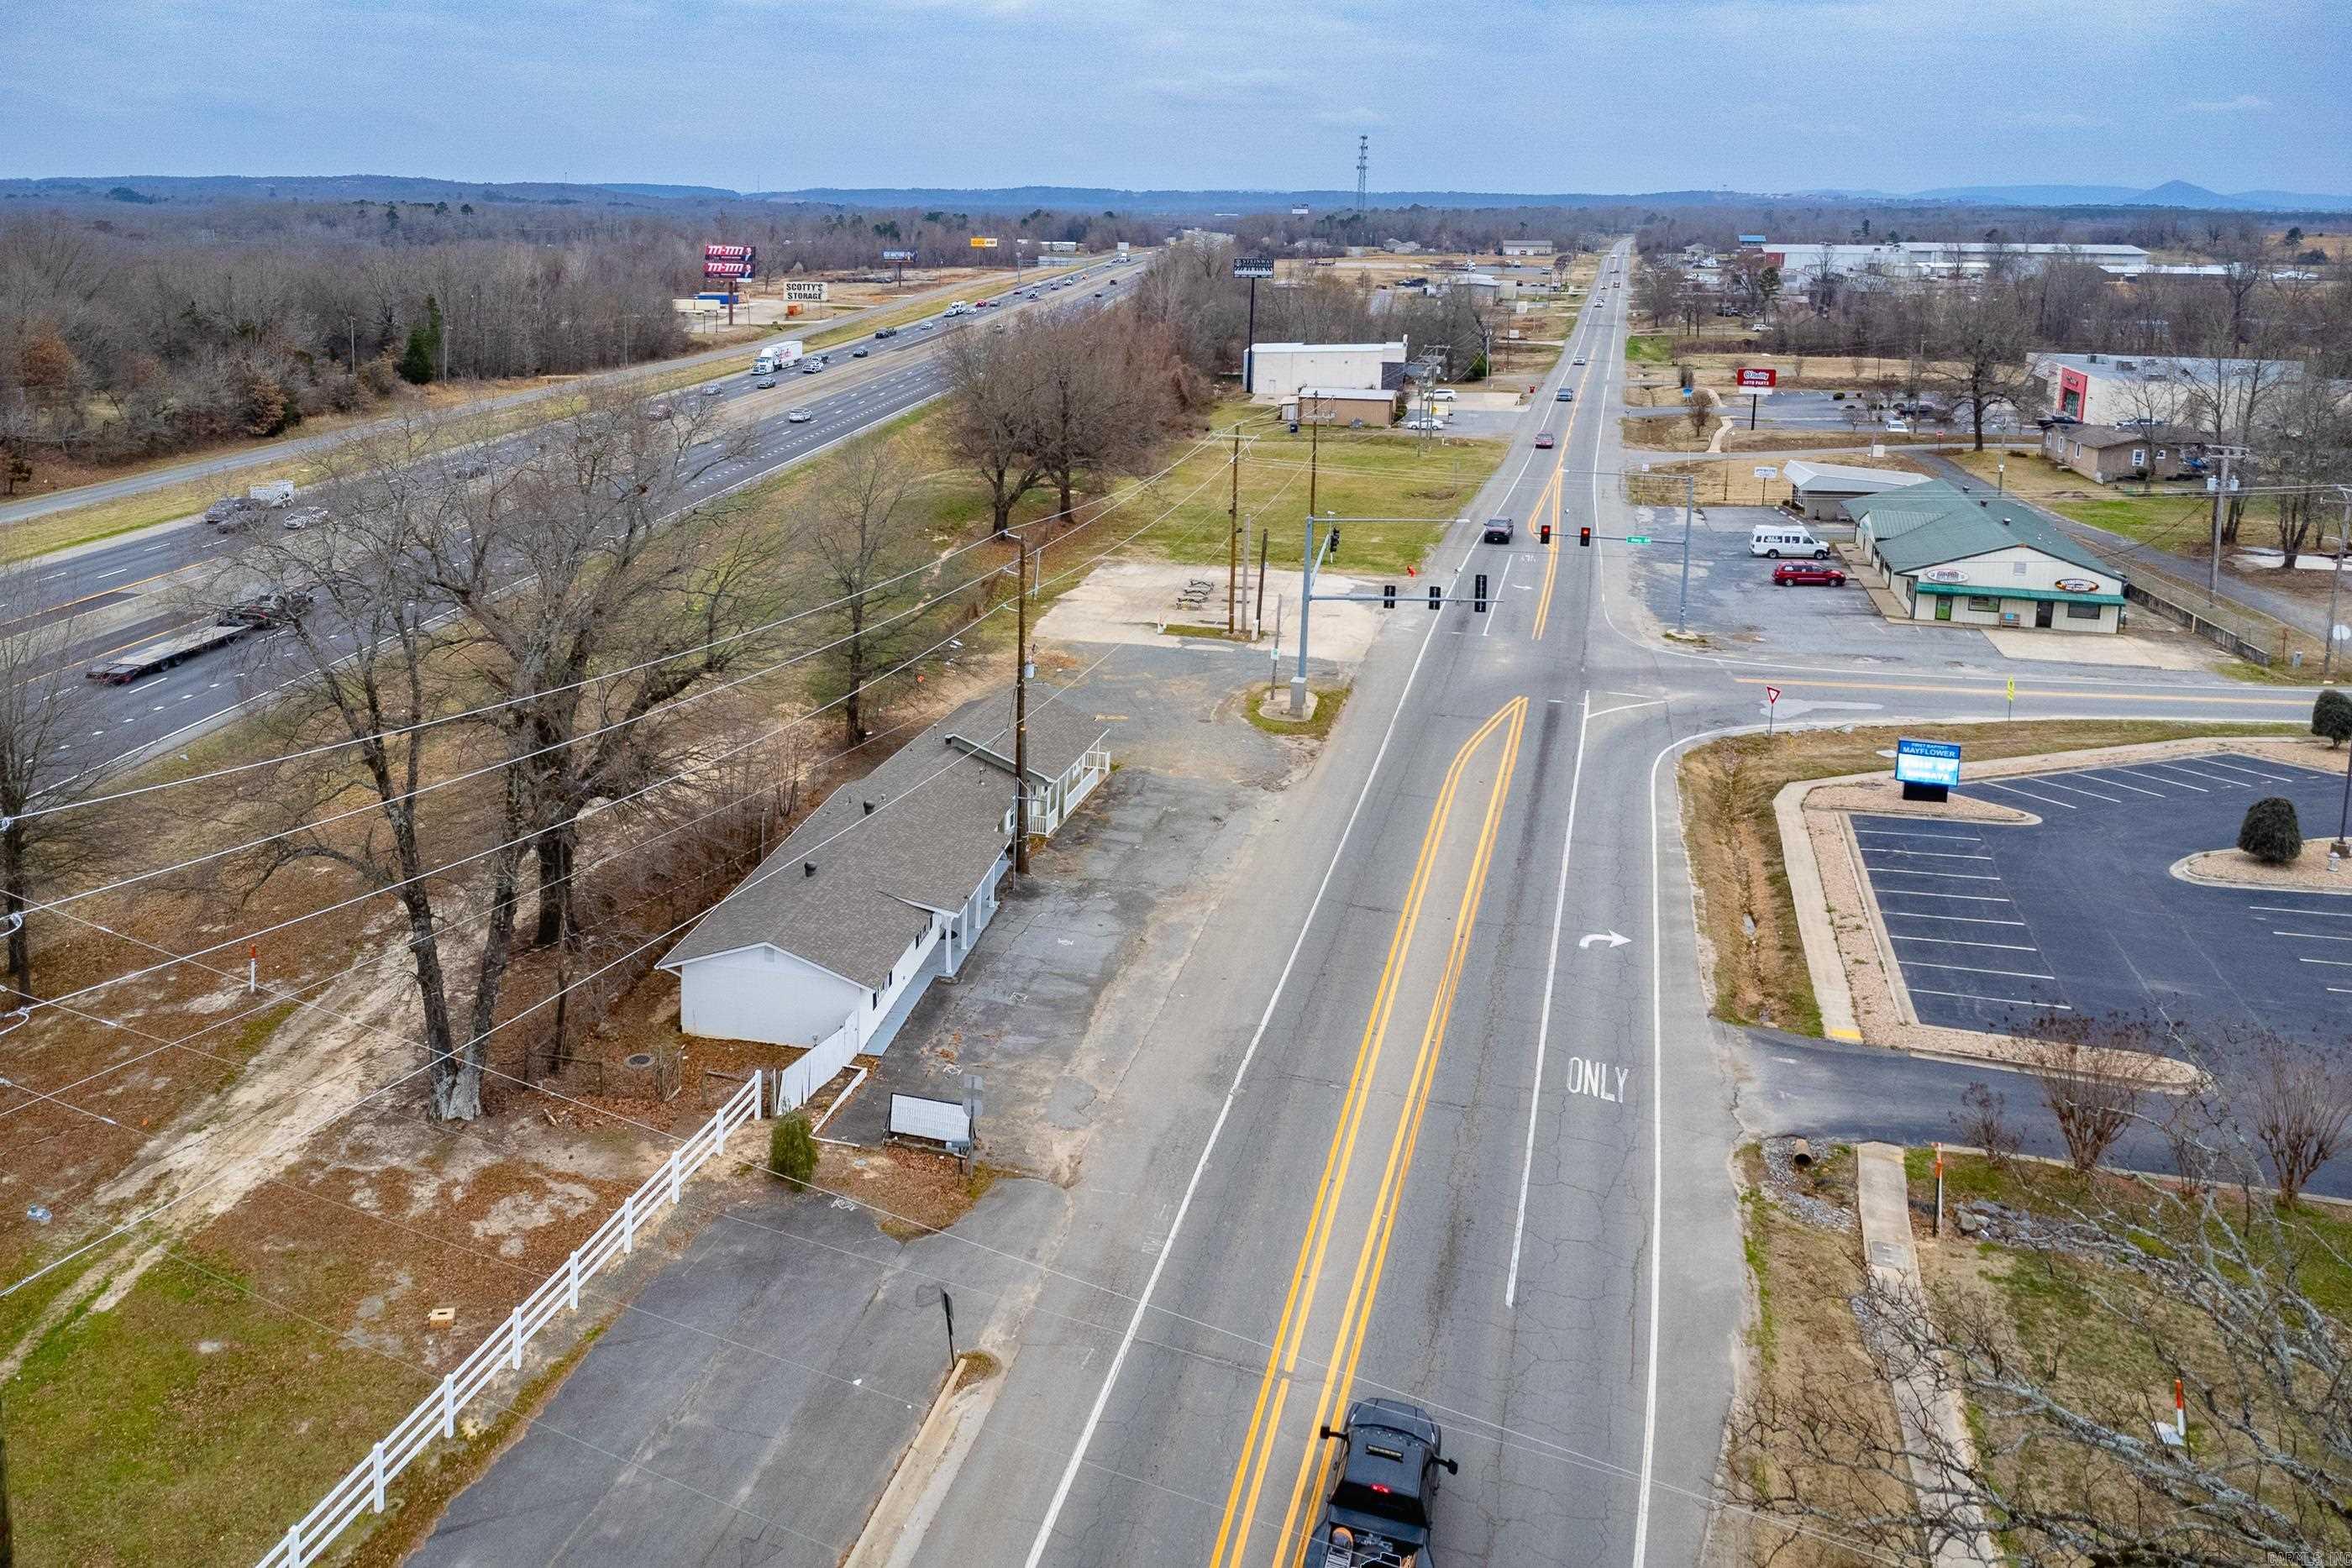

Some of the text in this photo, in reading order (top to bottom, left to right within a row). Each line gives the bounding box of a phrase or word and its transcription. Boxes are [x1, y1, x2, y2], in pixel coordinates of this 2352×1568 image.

[786, 283, 823, 291] SCOTTY'S
[1903, 747, 1956, 758] MAYFLOWER
[1567, 1057, 1629, 1104] ONLY
